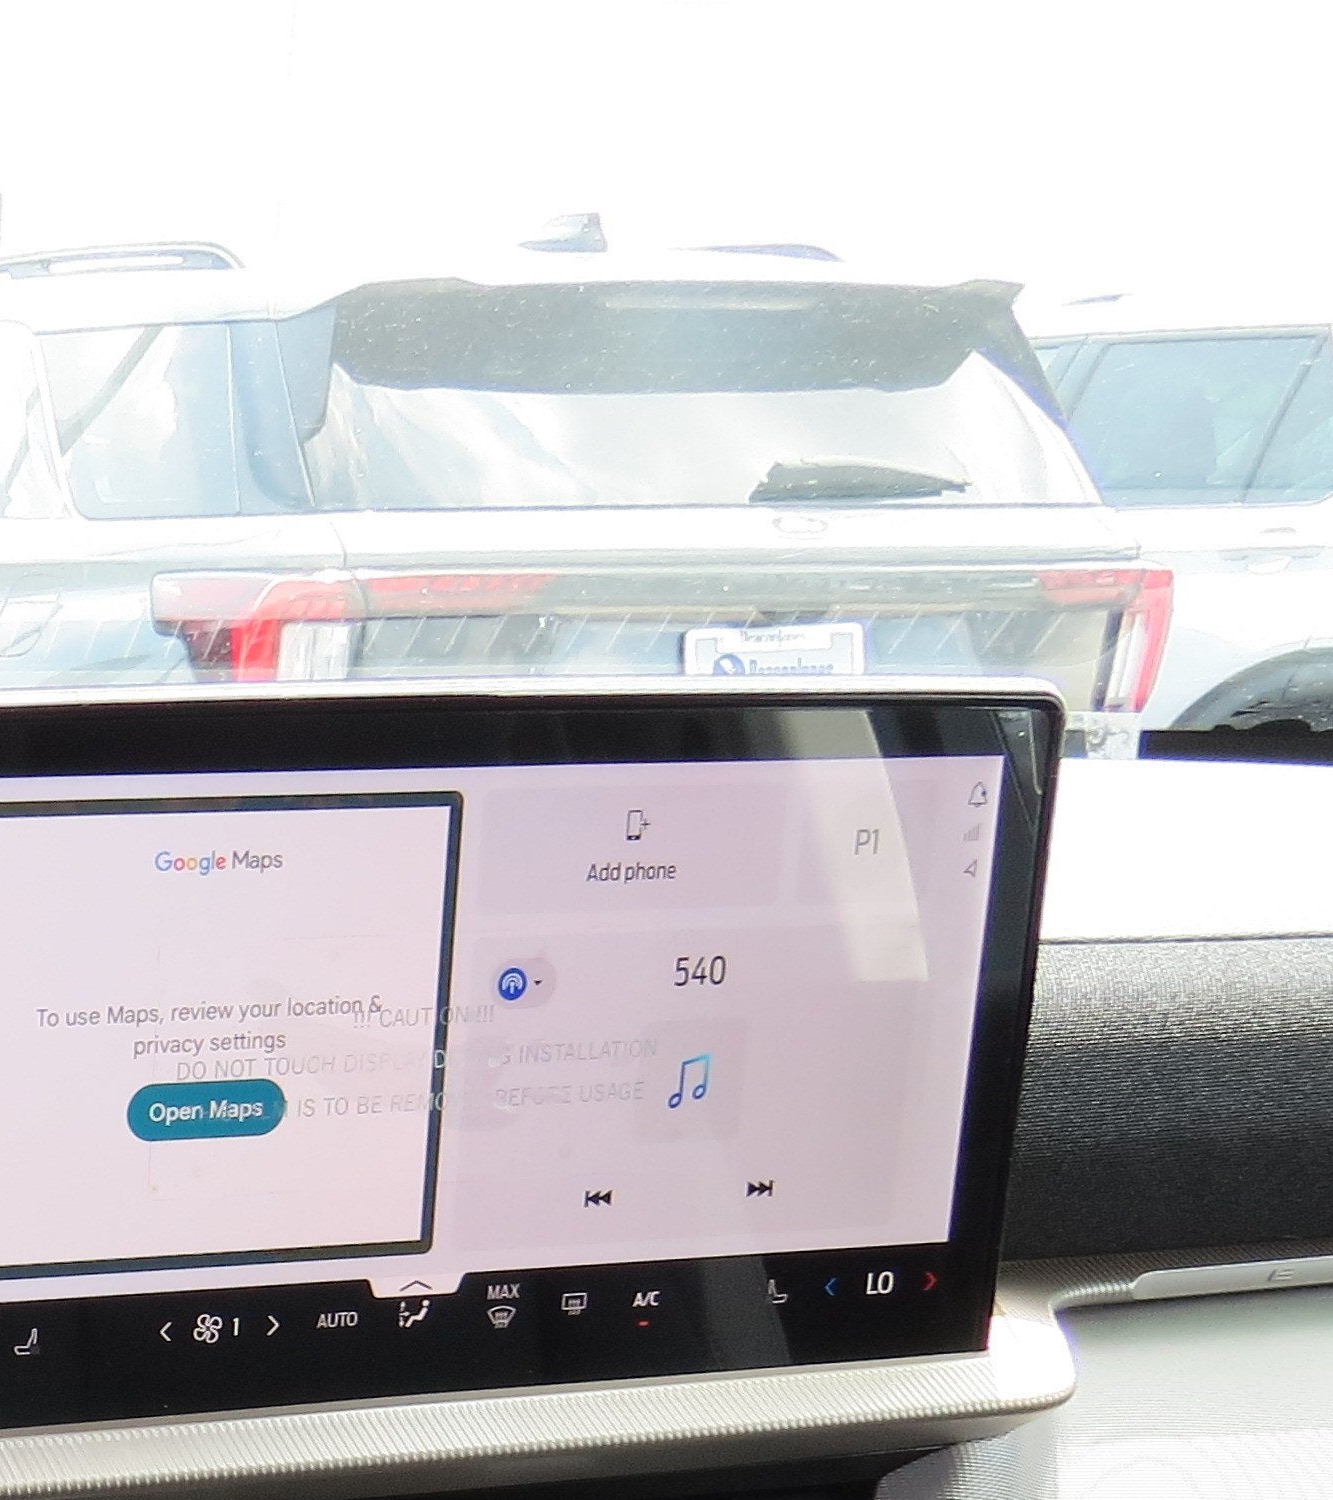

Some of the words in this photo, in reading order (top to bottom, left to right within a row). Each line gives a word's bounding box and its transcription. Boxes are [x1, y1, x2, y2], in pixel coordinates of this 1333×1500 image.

[853, 828, 881, 855] P1
[154, 850, 227, 876] Google
[231, 849, 284, 874] Maps
[585, 862, 621, 882] Add
[624, 862, 677, 884] phone
[673, 955, 727, 987] 540
[36, 1008, 60, 1028] To
[65, 1010, 101, 1026] use
[106, 1005, 165, 1028] Maps,
[170, 1001, 235, 1023] review
[238, 1002, 283, 1024] your
[287, 996, 363, 1017] location
[367, 995, 383, 1014] &
[132, 1032, 205, 1060] privacy
[209, 1030, 287, 1056] settings
[176, 1061, 207, 1081] DO
[214, 1057, 256, 1080] NOT
[264, 1054, 335, 1077] TOUCH
[148, 1101, 203, 1127] Open
[208, 1098, 264, 1125] Maps
[297, 1098, 316, 1118] IS
[323, 1097, 350, 1117] TO
[356, 1095, 384, 1115] BE
[486, 1282, 521, 1300] MAX
[865, 1271, 896, 1296] LO
[632, 1290, 661, 1308] A/C
[316, 1311, 359, 1330] AUTO
